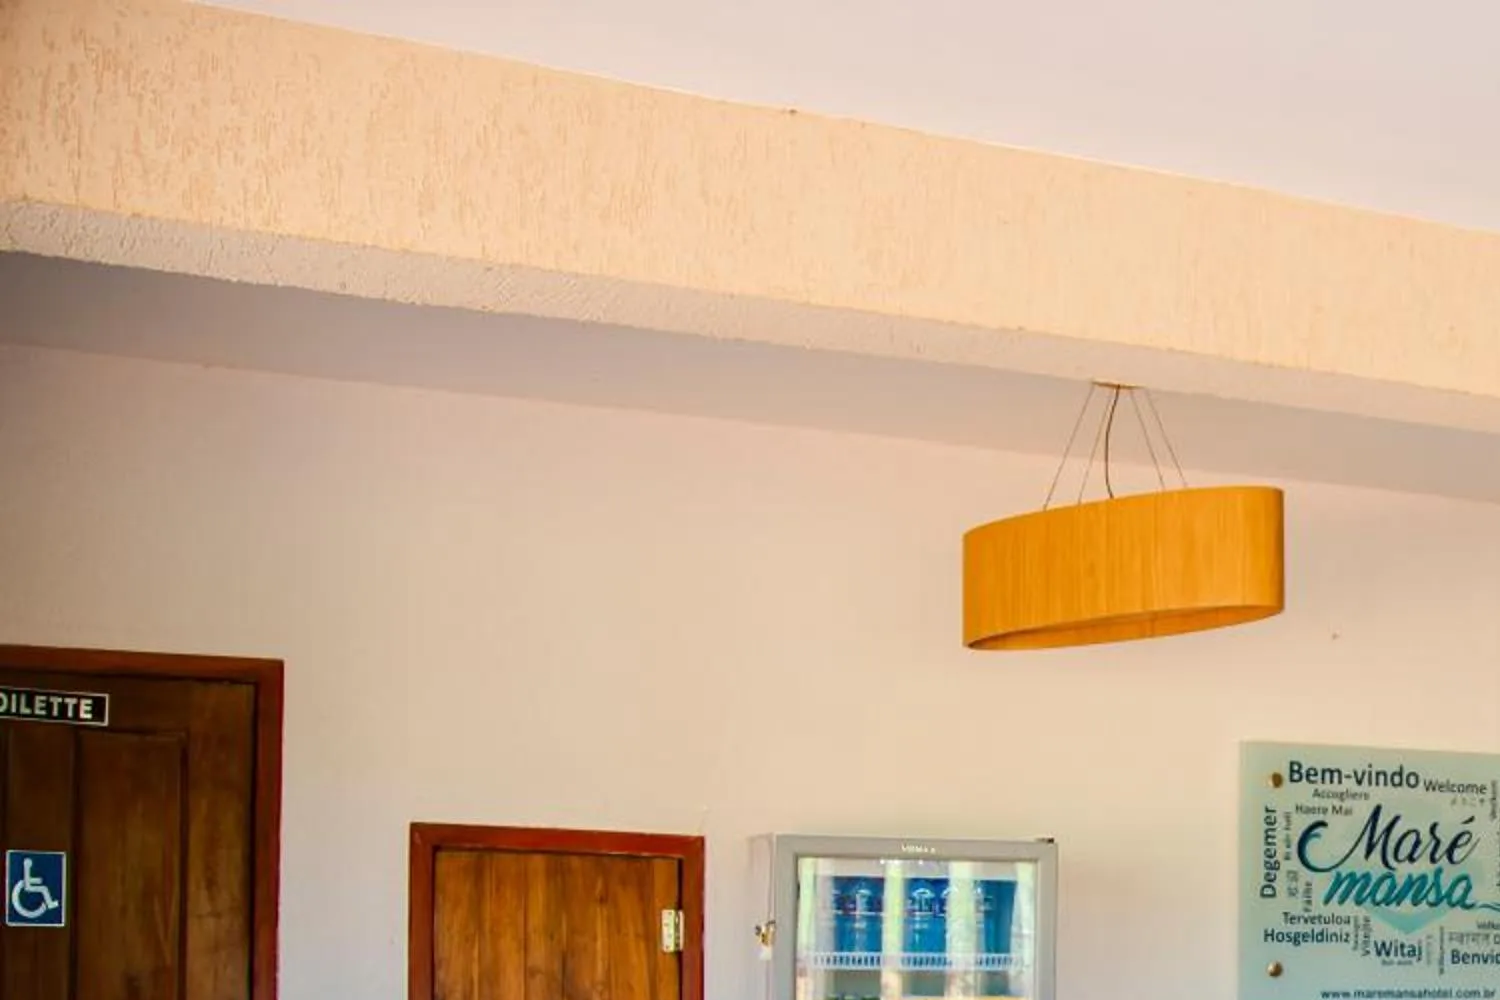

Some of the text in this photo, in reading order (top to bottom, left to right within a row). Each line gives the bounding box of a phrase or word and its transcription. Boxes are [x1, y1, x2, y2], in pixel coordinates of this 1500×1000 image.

[1289, 760, 1419, 788] Bem-vindo
[1424, 779, 1488, 795] Welcome
[1297, 803, 1481, 872] Maré
[1260, 805, 1280, 898] Degemer
[1322, 865, 1477, 910] mansa
[1282, 911, 1350, 925] Tervetuloa
[1263, 929, 1350, 946] Hosgeldiniz
[1374, 939, 1422, 962] Witaj
